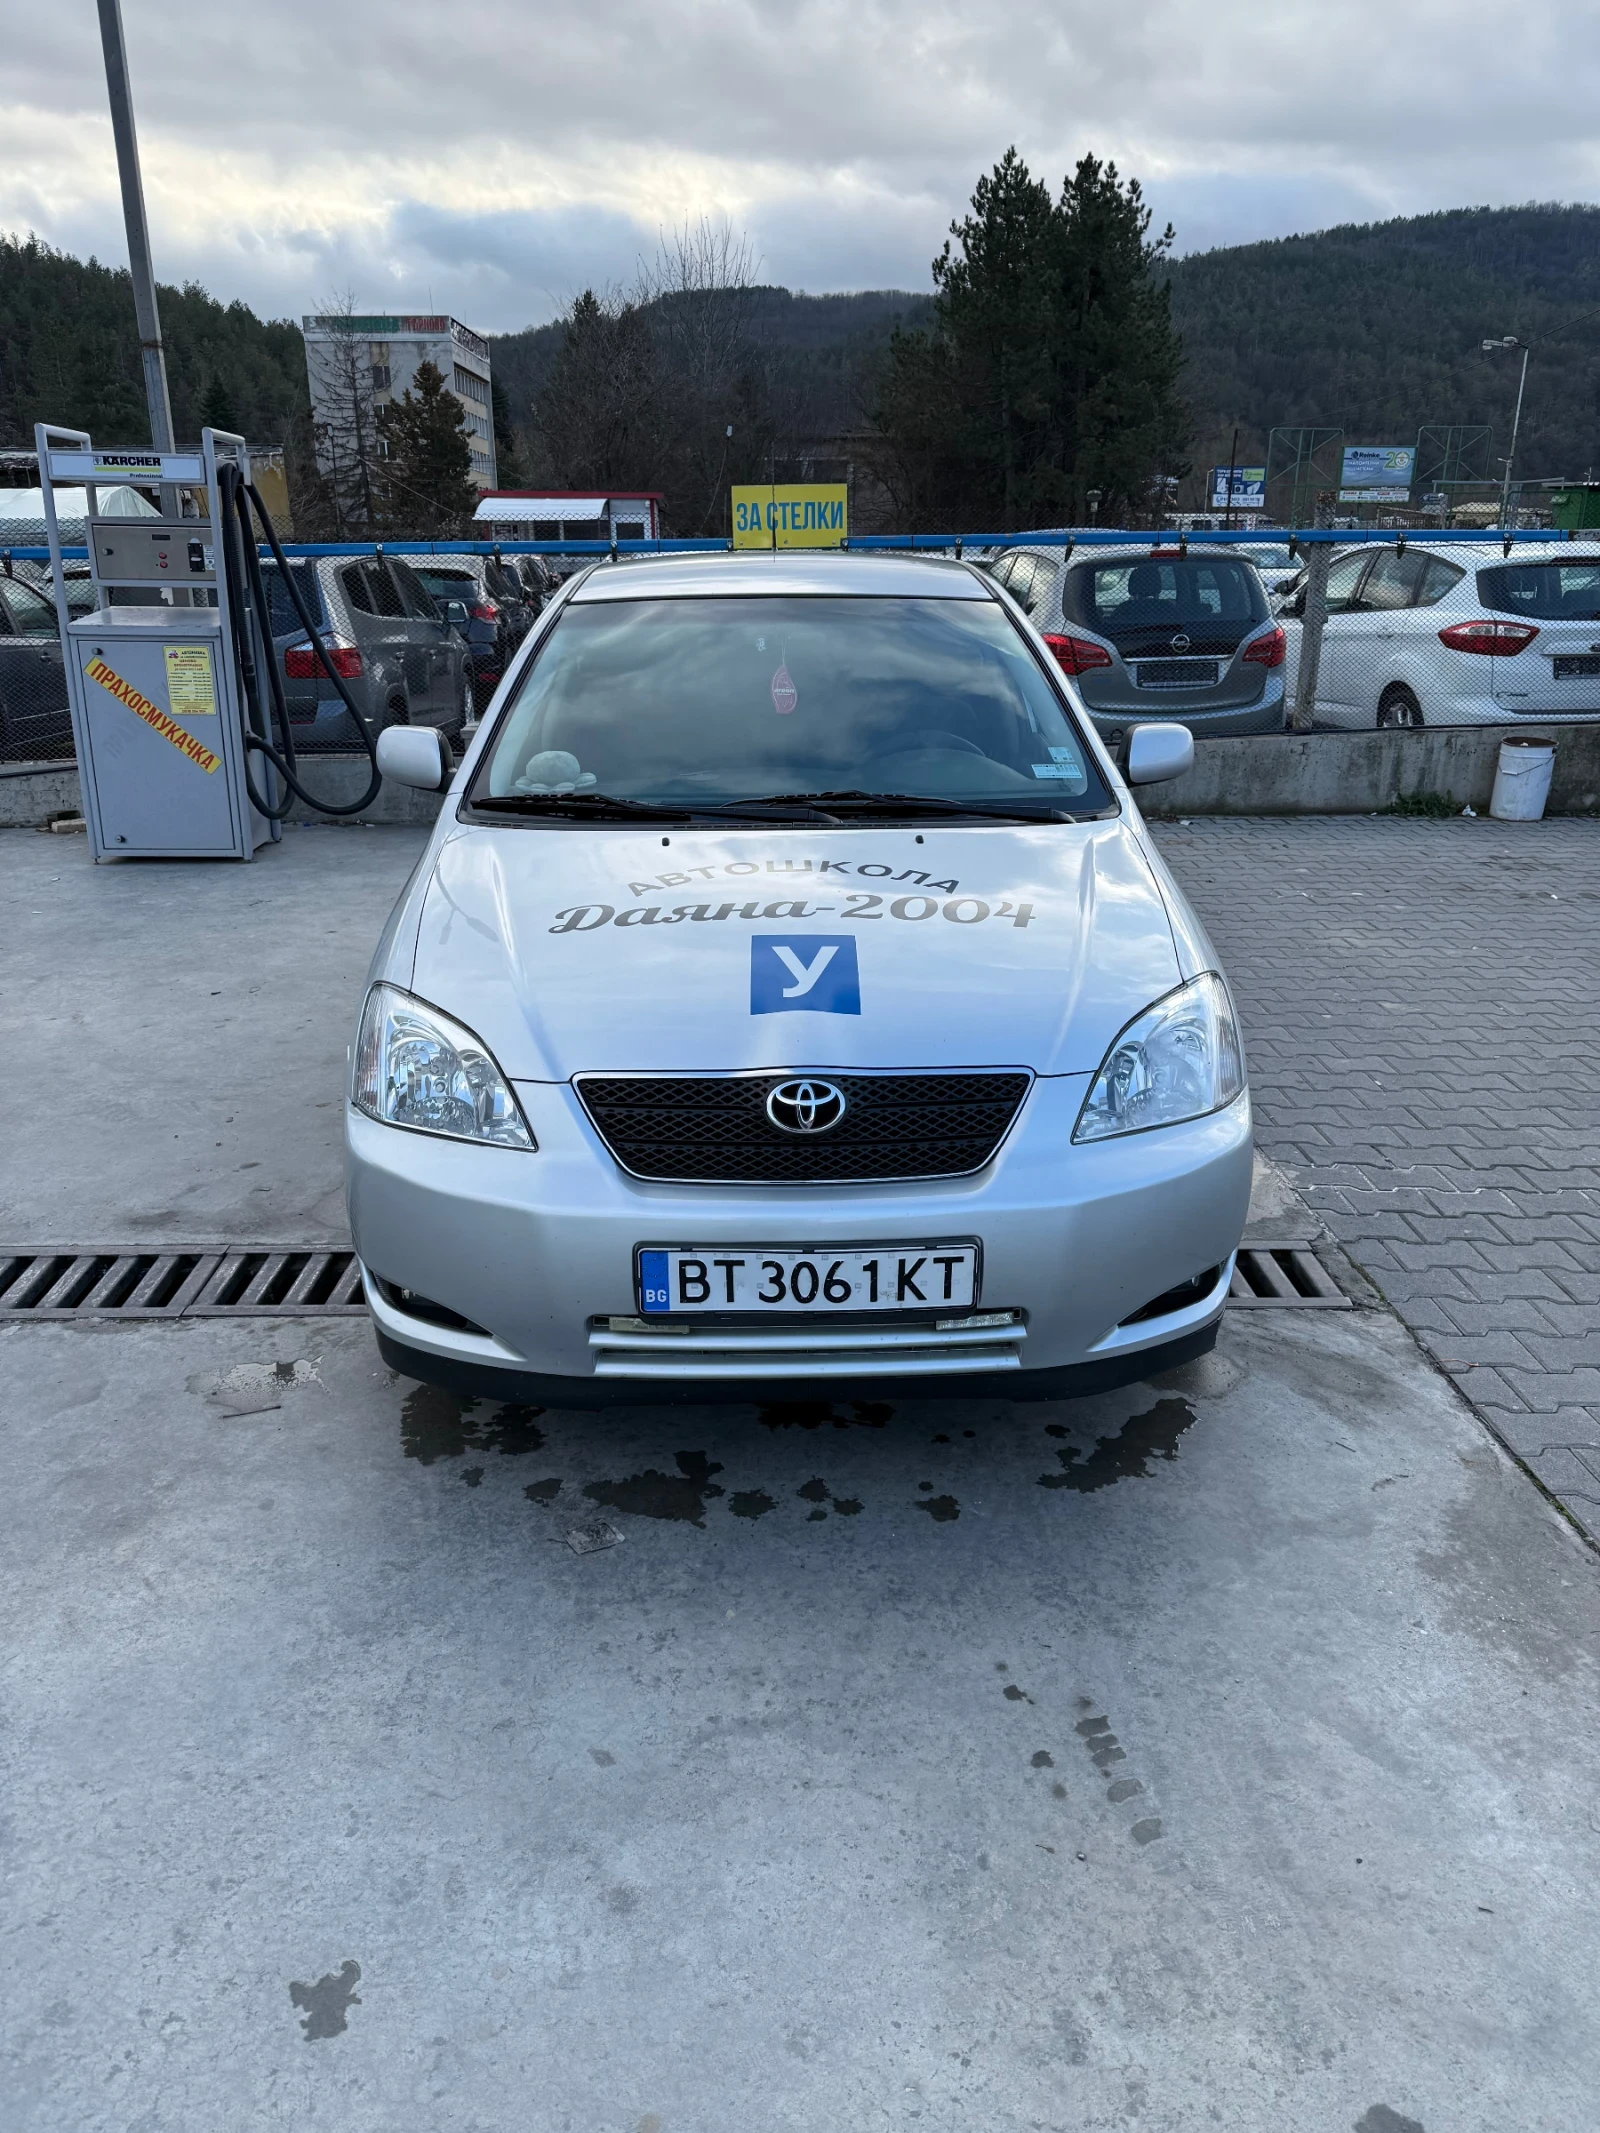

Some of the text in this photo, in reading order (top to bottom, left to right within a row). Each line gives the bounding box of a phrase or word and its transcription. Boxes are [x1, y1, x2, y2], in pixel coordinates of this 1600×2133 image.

[1359, 451, 1380, 459] Reinke
[736, 501, 843, 531] ЗА СТЕЛКИ
[91, 662, 214, 770] ПРАХОСМУКАЧКА
[627, 859, 960, 897] АВТОШКОЛА
[548, 894, 1037, 934] Даяна-2004
[645, 1289, 667, 1302] BG
[679, 1256, 965, 1303] BT 3061 KT
